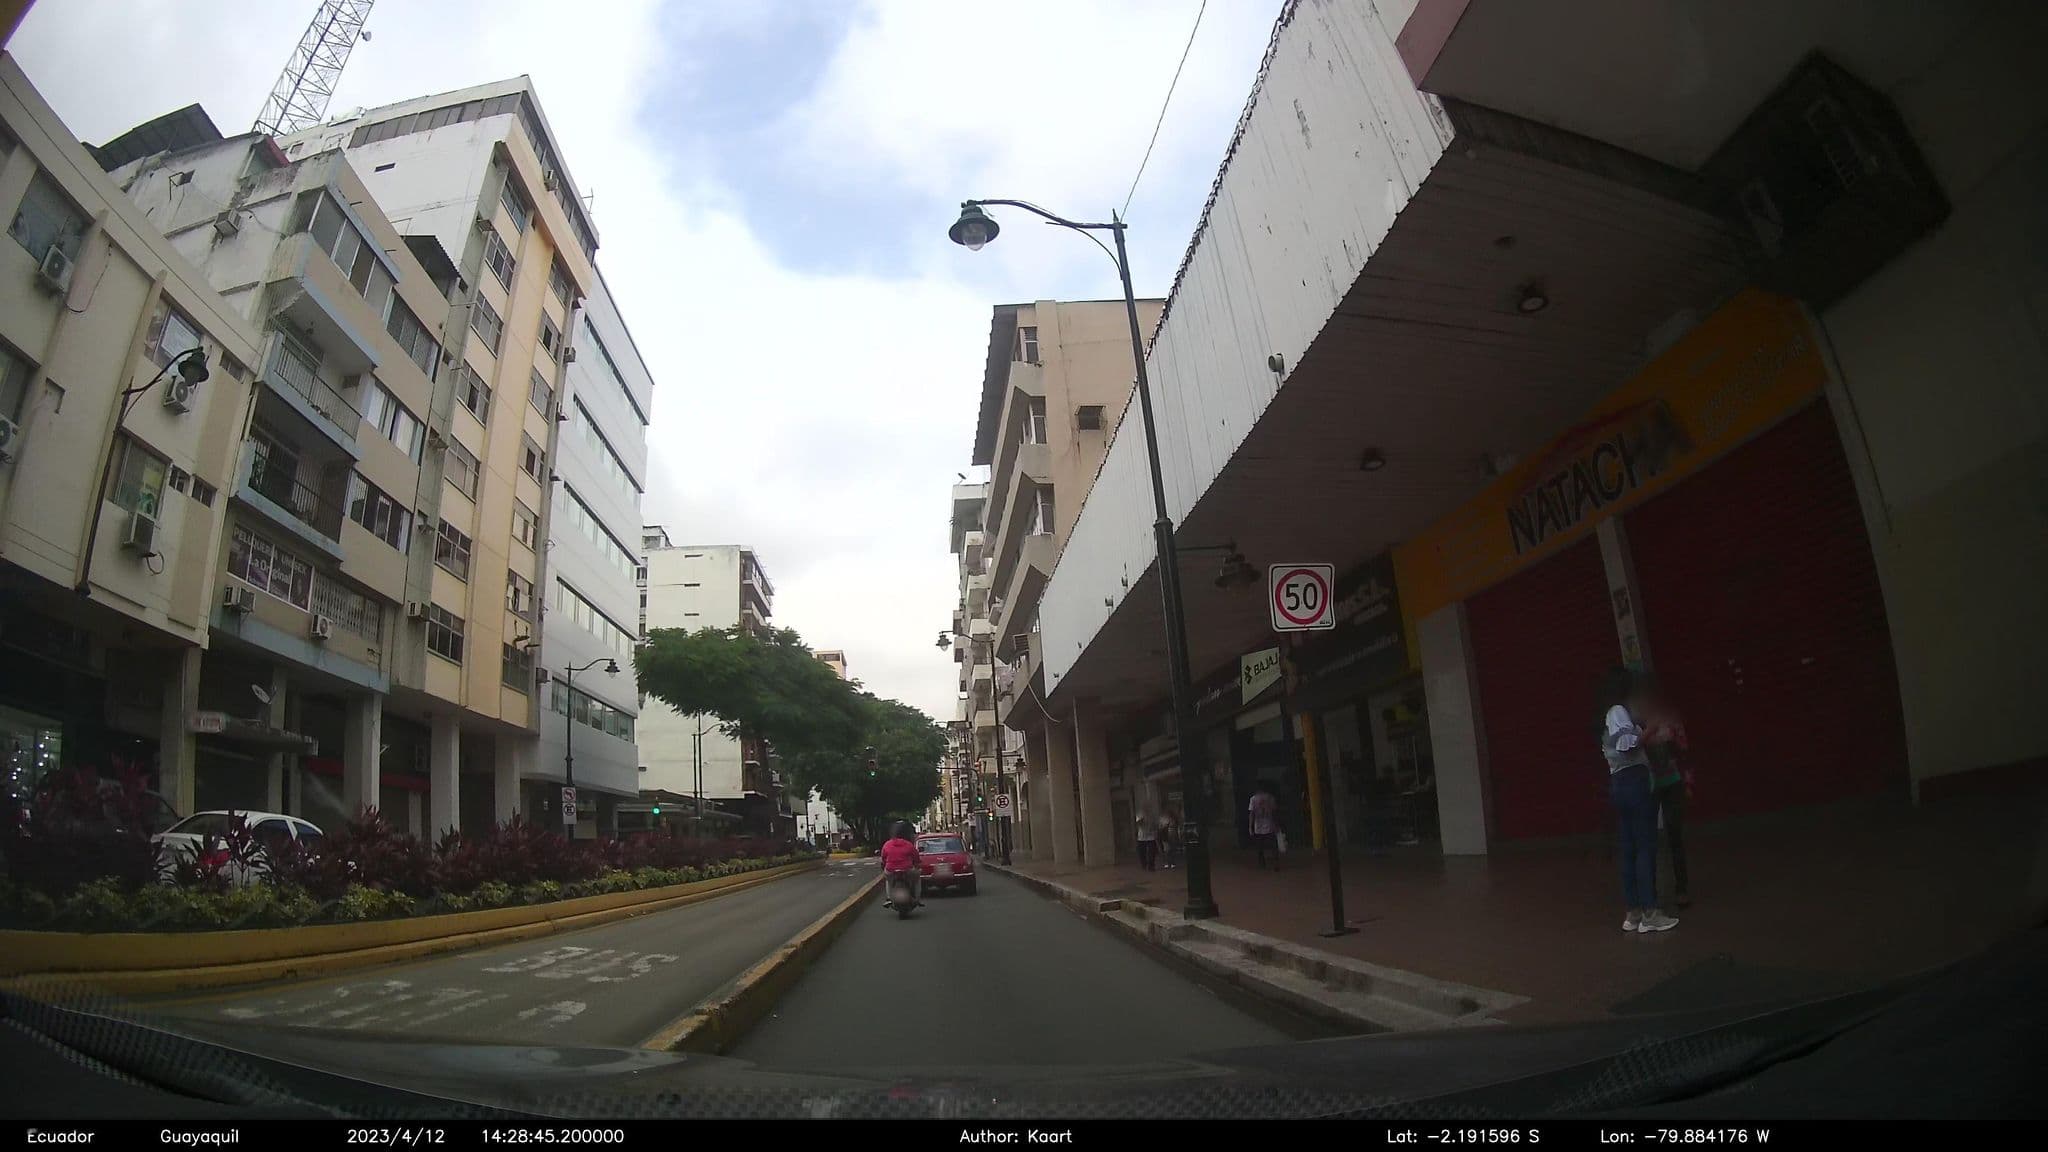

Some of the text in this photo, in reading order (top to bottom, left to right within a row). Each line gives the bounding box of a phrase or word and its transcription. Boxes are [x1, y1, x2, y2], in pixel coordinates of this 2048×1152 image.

[1506, 404, 1697, 554] NATACHA
[234, 527, 278, 560] PELUQUERA
[260, 559, 291, 584] Orginal
[1286, 583, 1318, 611] 50
[1254, 652, 1278, 676] BAJAJ
